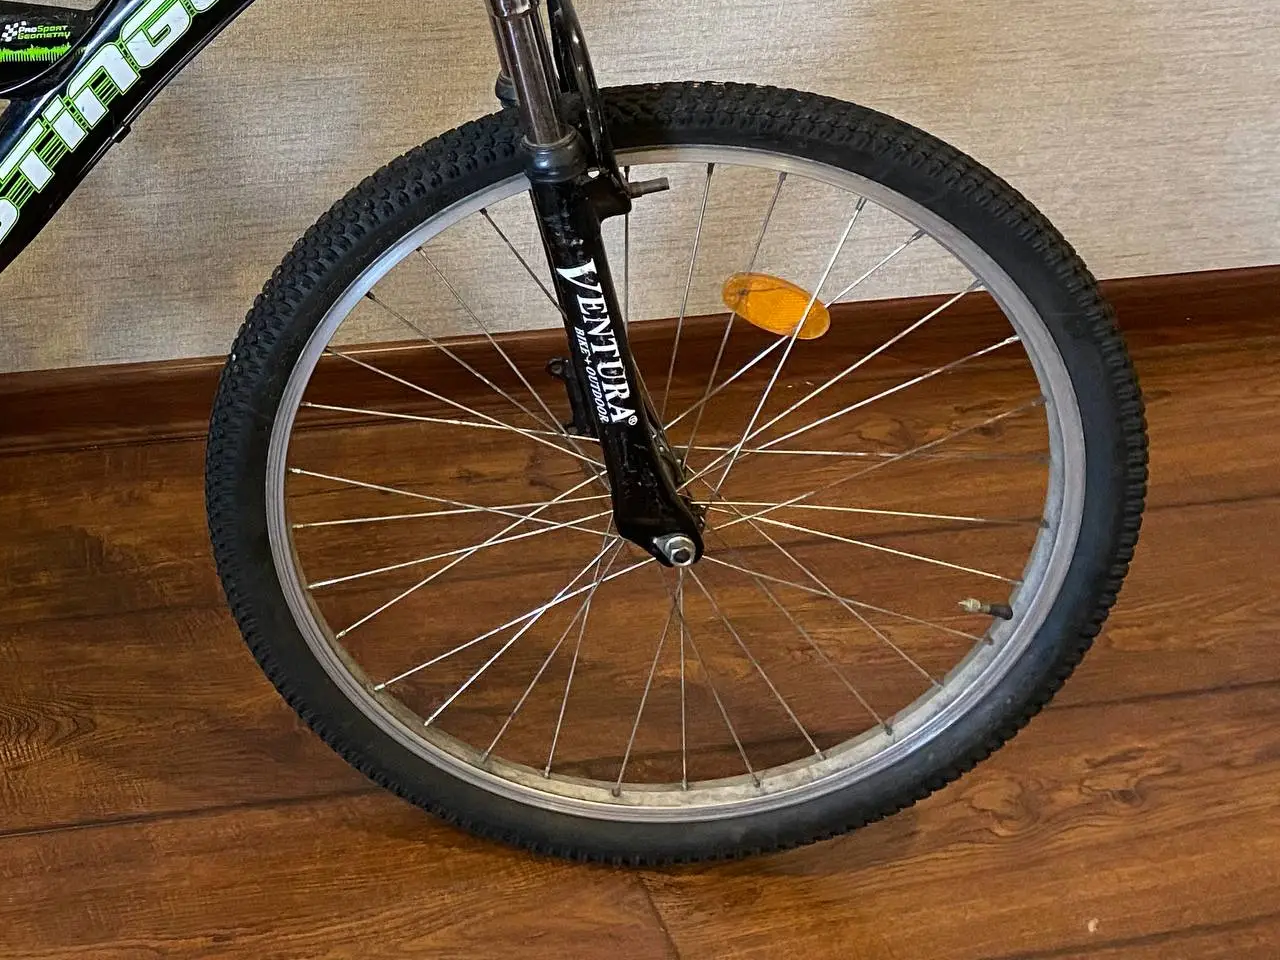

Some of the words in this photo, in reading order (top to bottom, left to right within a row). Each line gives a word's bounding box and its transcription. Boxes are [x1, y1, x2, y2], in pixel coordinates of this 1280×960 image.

[556, 257, 636, 424] VENTURA
[574, 326, 591, 355] BIKE
[585, 366, 610, 424] OUTDOOR
